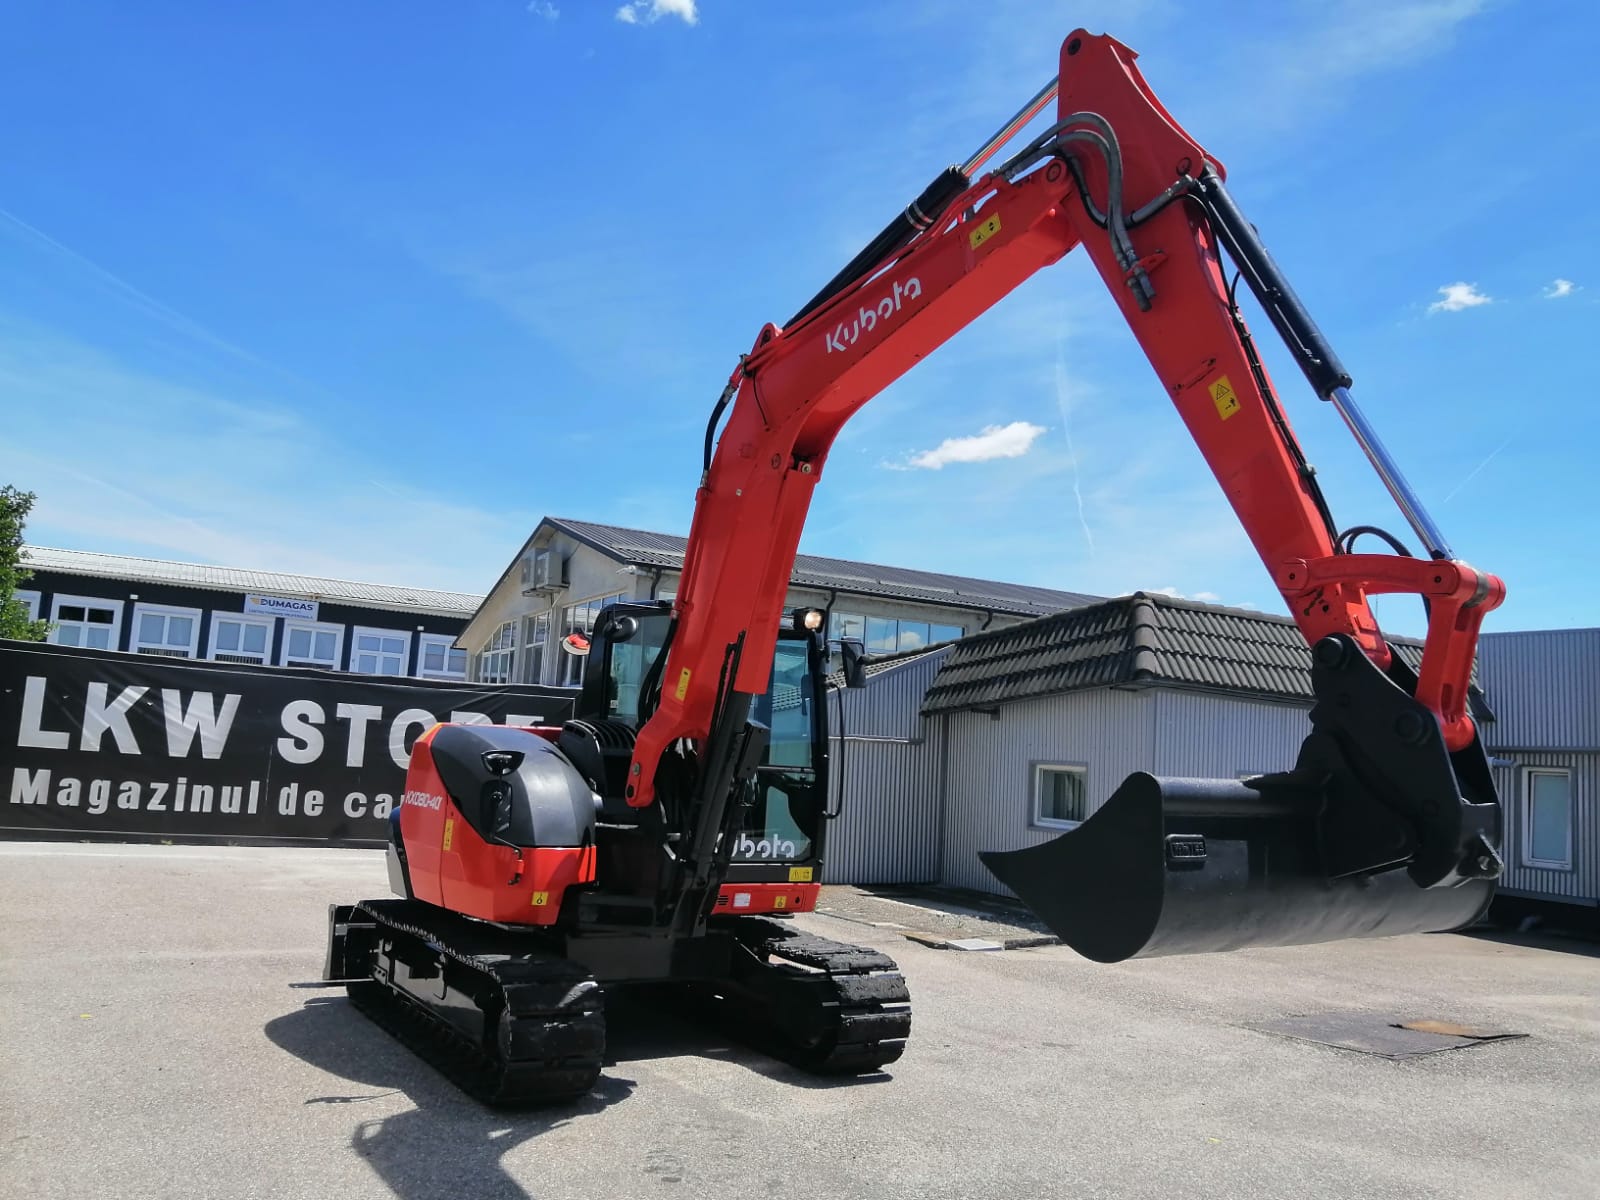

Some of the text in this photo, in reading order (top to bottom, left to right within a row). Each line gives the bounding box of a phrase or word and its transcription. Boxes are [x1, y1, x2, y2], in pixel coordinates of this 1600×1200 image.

[825, 277, 922, 354] Kubota
[260, 598, 313, 611] DUMAGAS
[17, 676, 545, 771] LKW STO
[9, 767, 405, 821] Magazinul de ca
[714, 832, 795, 859] bota
